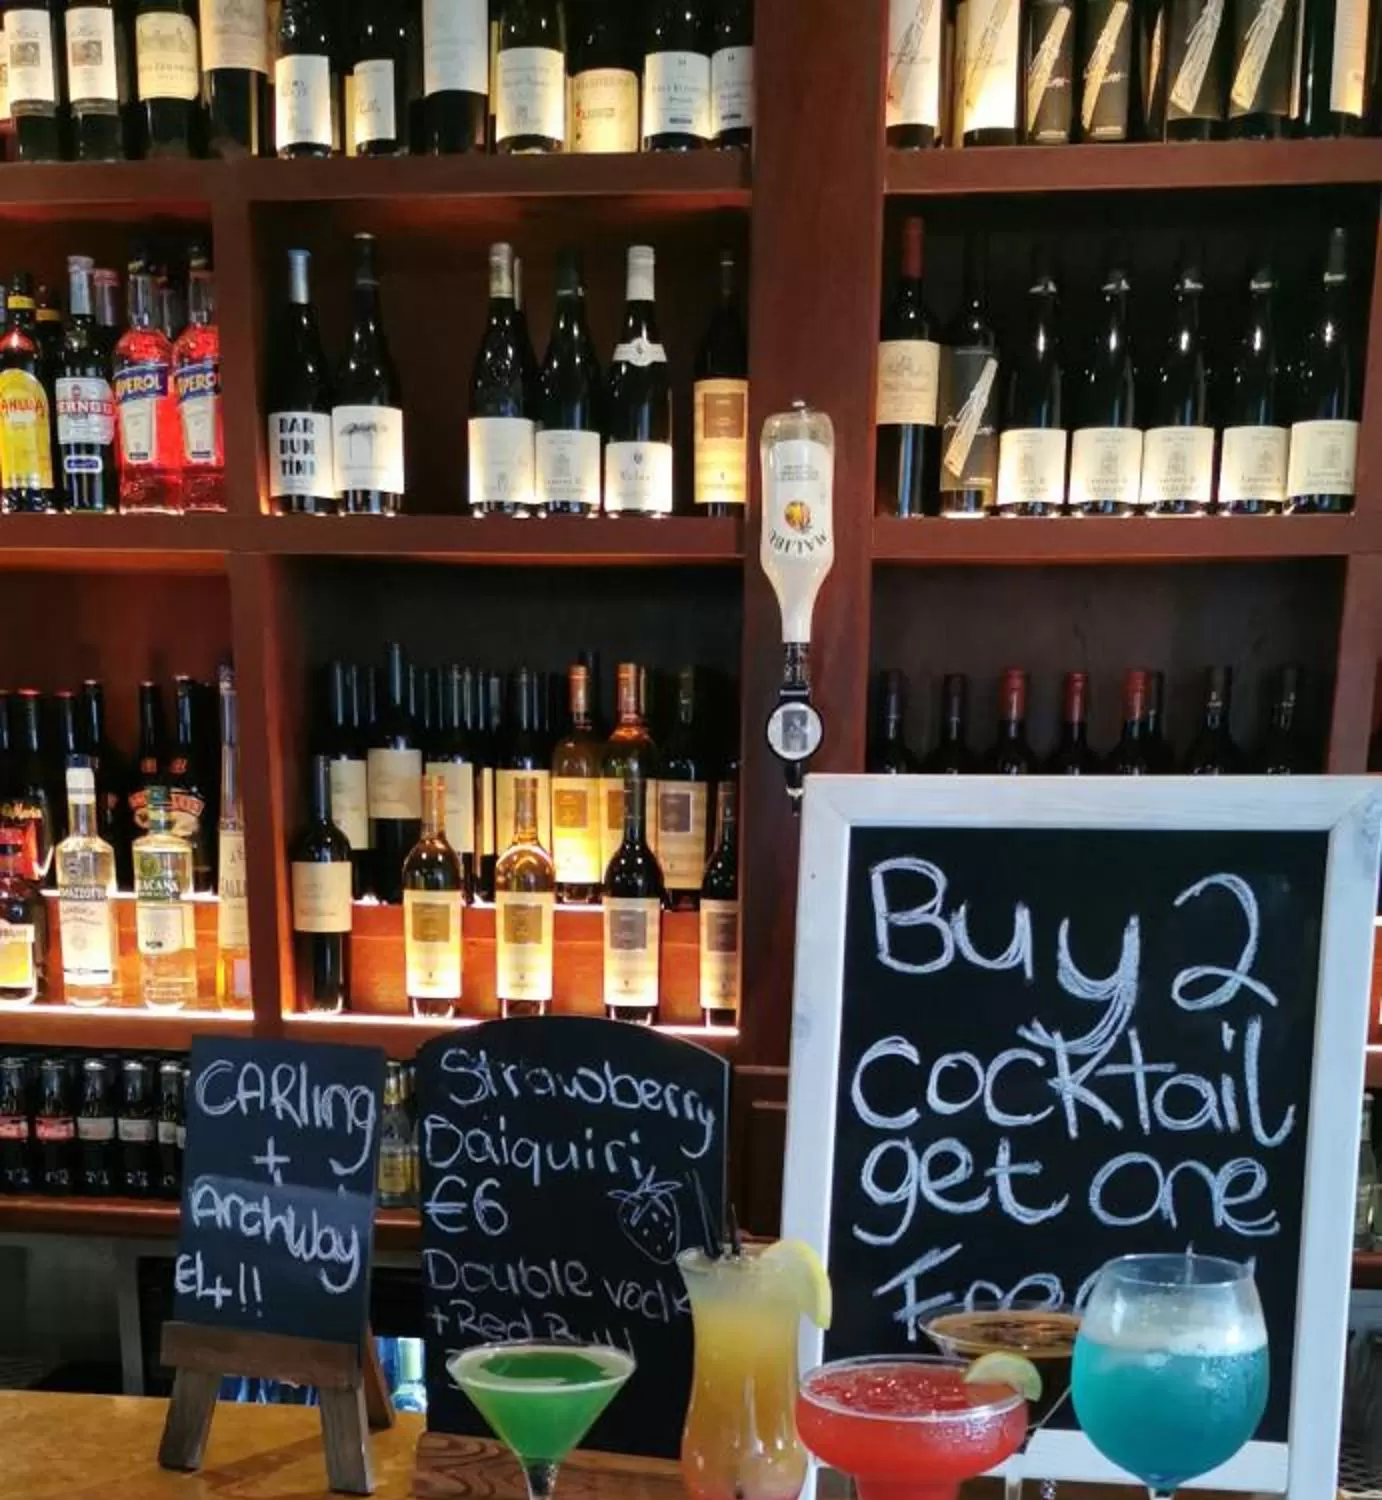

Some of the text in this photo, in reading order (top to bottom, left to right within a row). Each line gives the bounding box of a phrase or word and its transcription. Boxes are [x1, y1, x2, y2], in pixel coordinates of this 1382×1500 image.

[279, 417, 315, 434] BAR
[869, 856, 1279, 1055] Buy 2
[440, 1048, 717, 1159] Strawberry
[423, 1113, 644, 1188] Daiquiri
[423, 1175, 510, 1236] €6
[853, 1136, 1281, 1245] get one
[423, 1248, 594, 1299] Double
